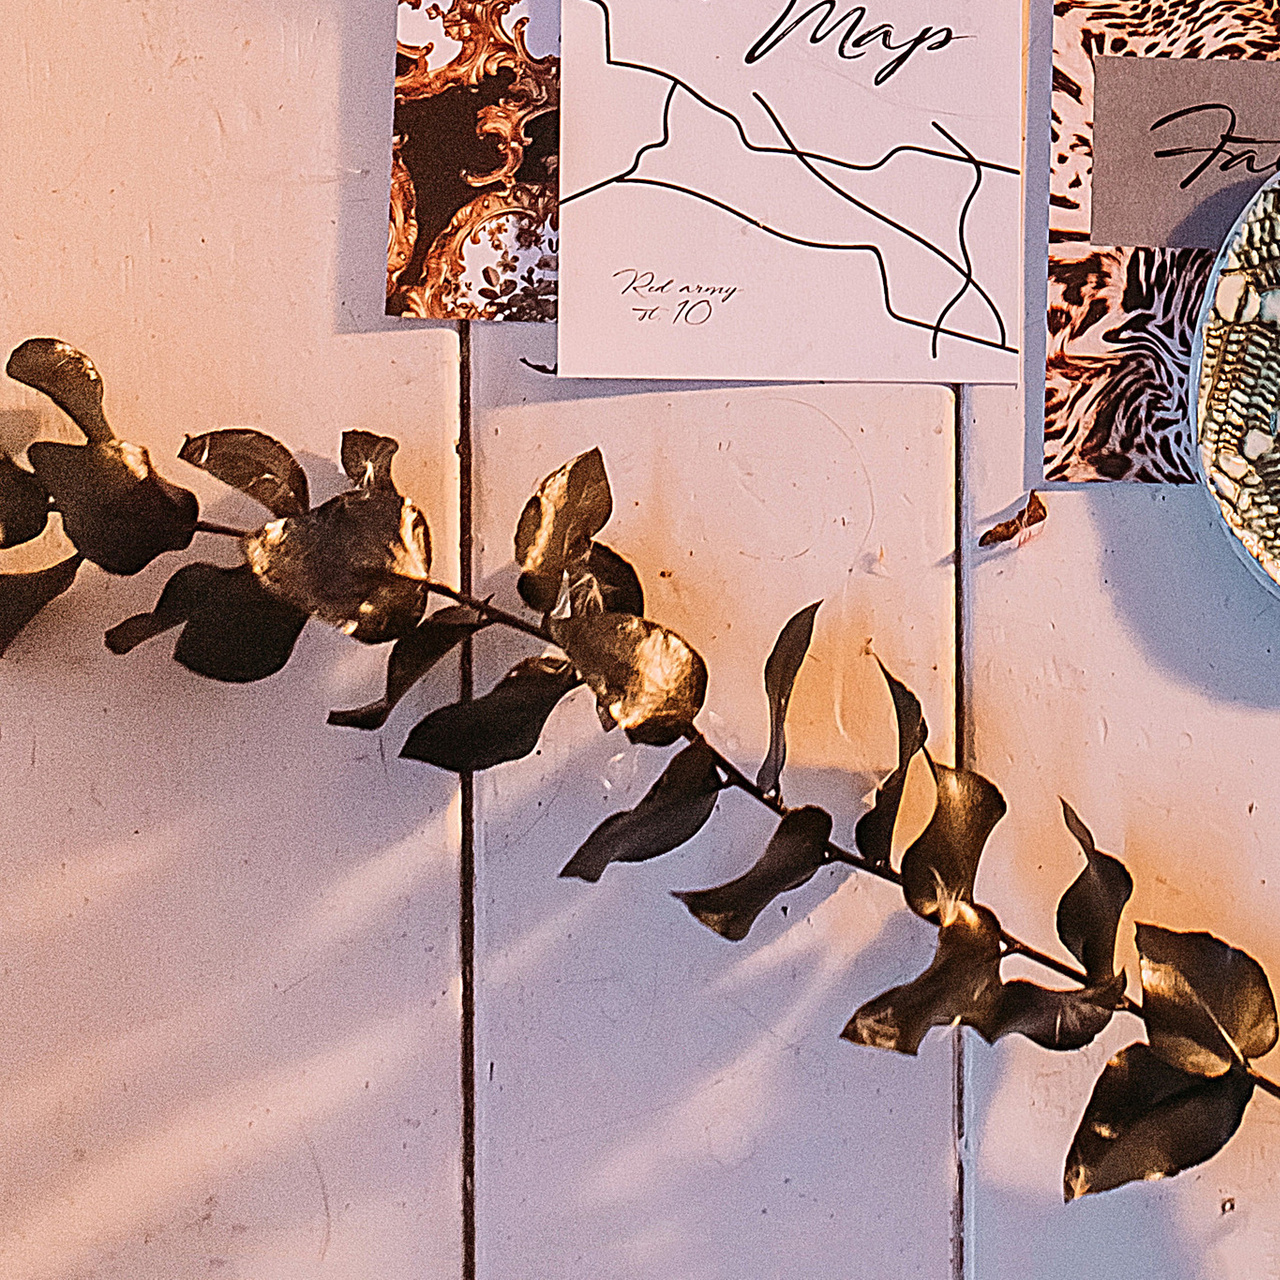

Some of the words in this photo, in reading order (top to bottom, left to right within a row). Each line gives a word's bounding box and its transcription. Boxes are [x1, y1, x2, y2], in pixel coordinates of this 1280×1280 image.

[612, 268, 674, 299] Red
[679, 284, 744, 303] army
[673, 299, 712, 326] 10
